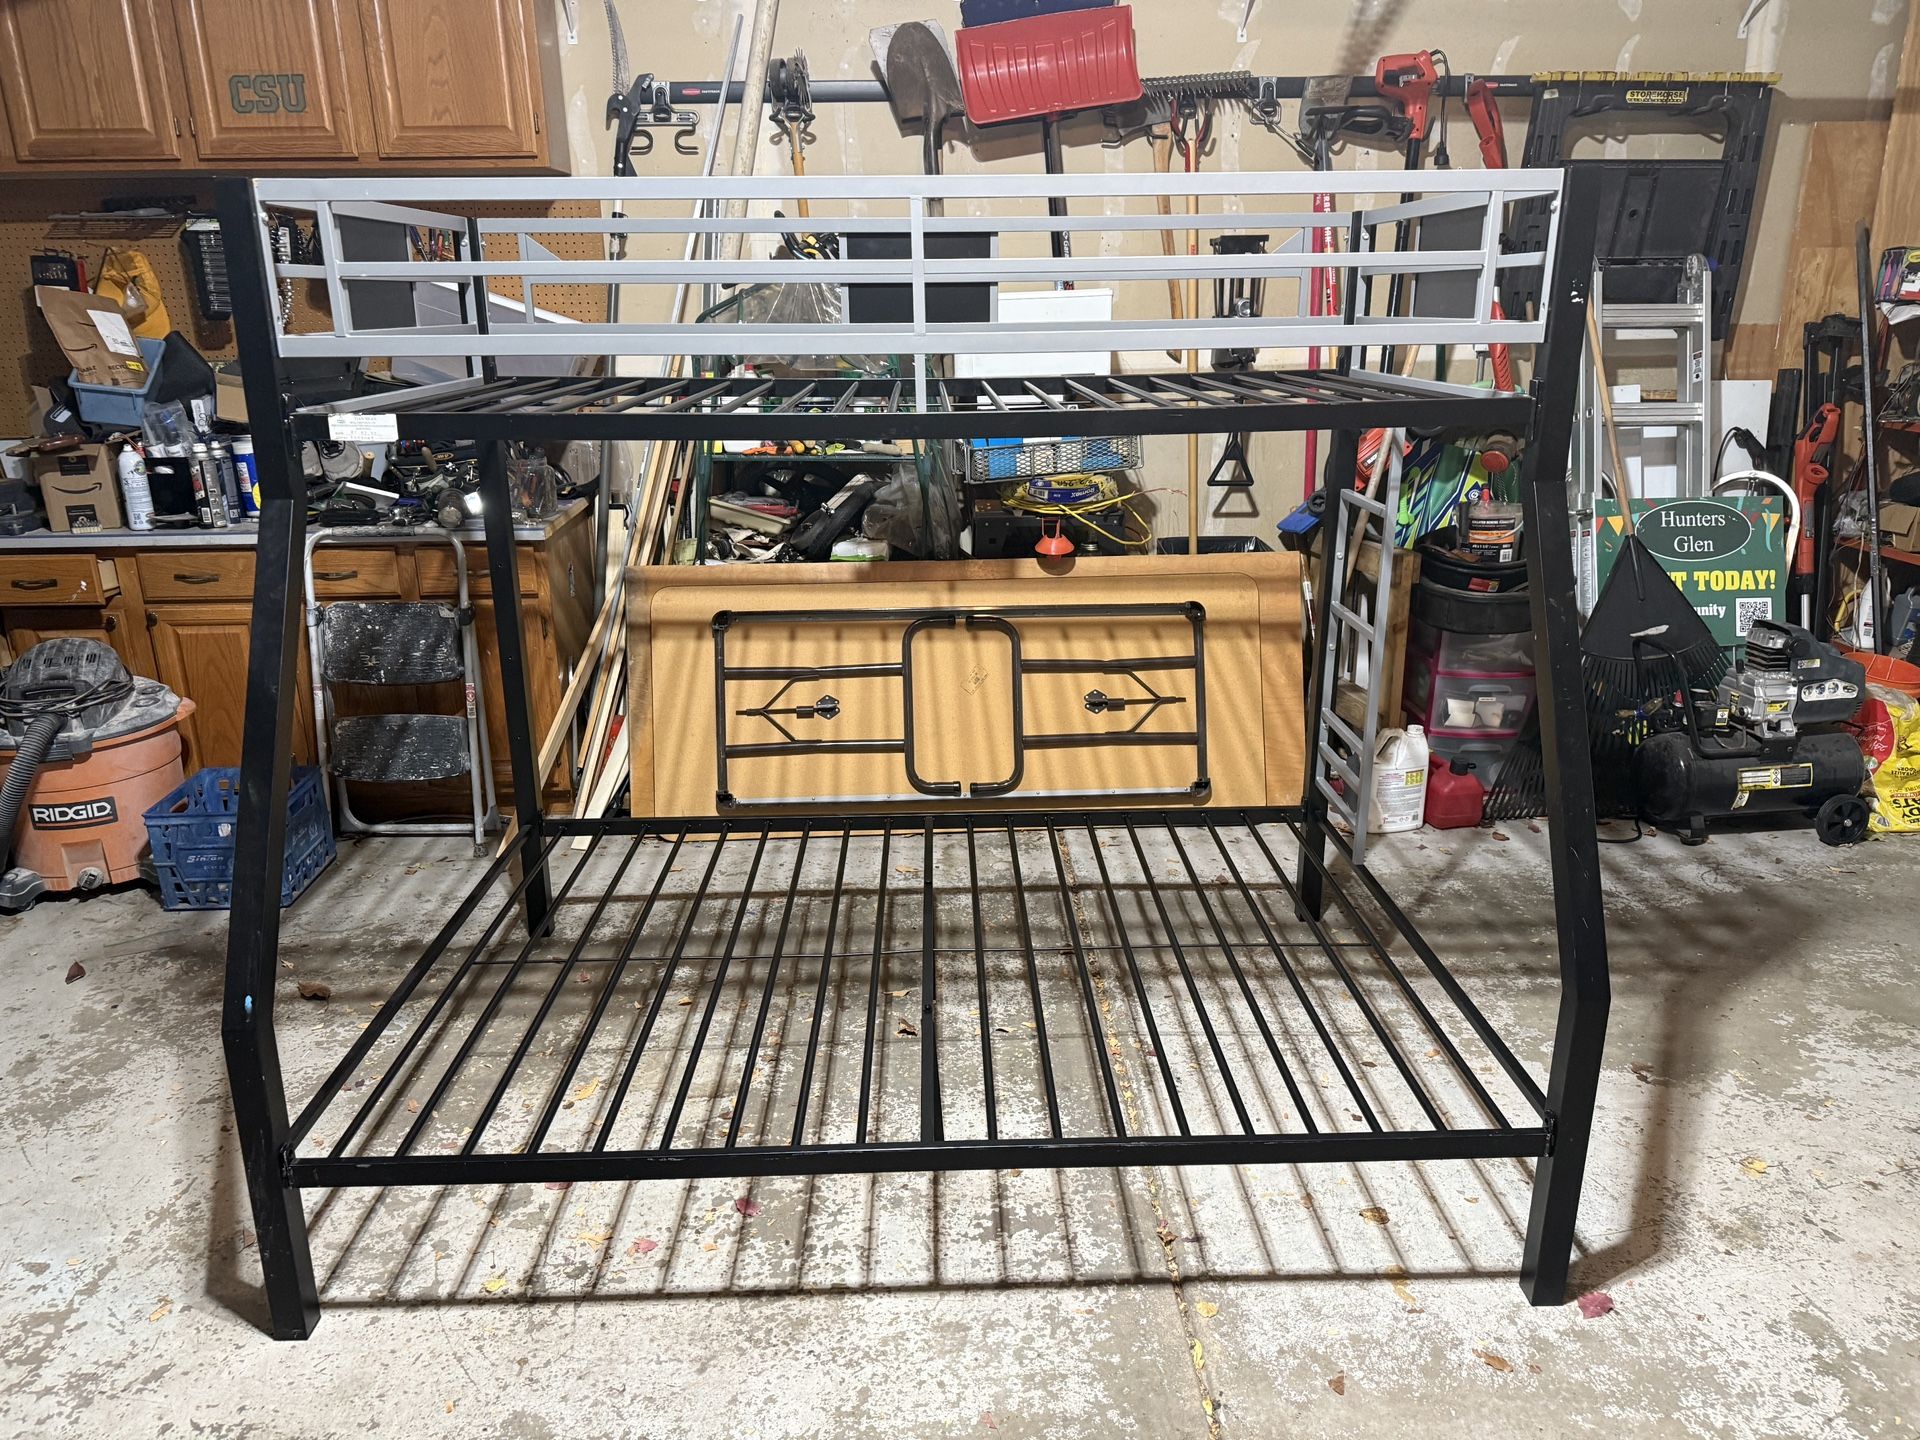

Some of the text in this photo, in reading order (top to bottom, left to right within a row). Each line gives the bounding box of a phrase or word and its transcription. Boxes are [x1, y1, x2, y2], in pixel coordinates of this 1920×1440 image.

[228, 74, 307, 114] CSU
[1070, 487, 1095, 498] Romex
[1660, 510, 1726, 527] Hunters
[1673, 536, 1715, 553] Glen
[1693, 569, 1777, 592] TODAY!
[1695, 603, 1727, 619] unity
[32, 801, 112, 822] RIDGID
[1892, 797, 1920, 809] ATS
[1901, 806, 1920, 819] DY
